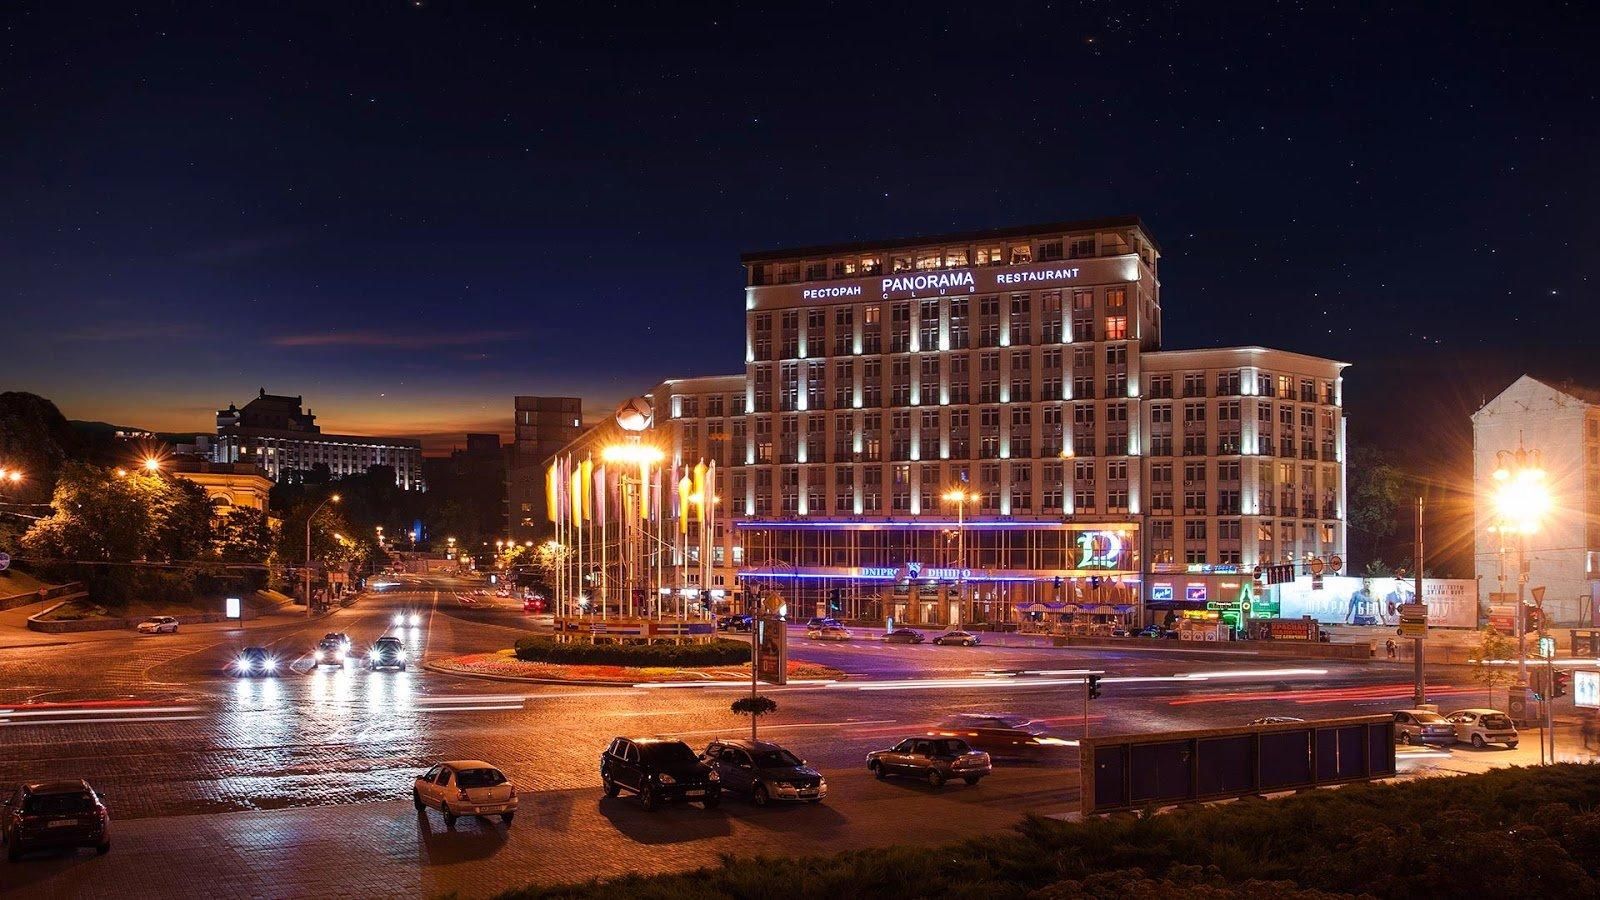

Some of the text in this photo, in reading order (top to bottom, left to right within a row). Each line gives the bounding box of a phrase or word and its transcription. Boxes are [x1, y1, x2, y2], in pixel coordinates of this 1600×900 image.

[882, 272, 974, 292] PANORAMA
[996, 268, 1080, 284] RESTAURANT
[803, 286, 861, 299] РЕСТОРАН
